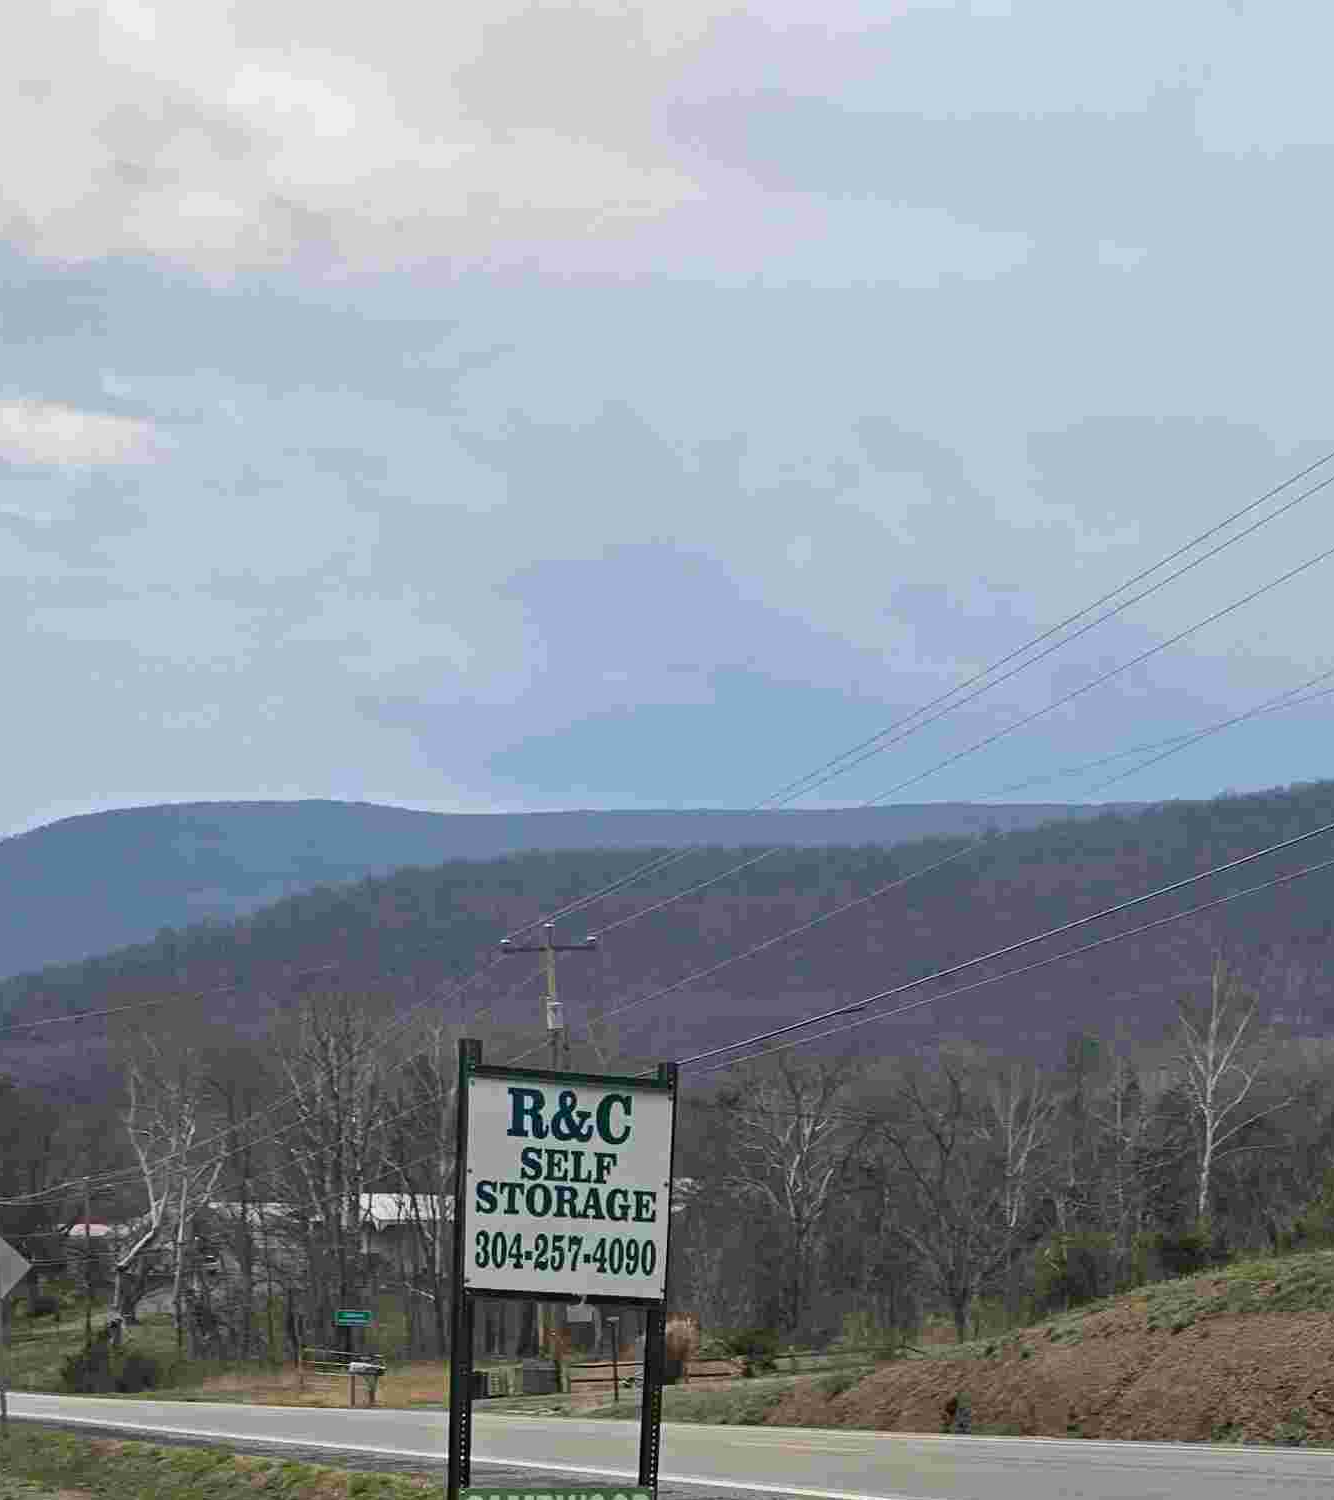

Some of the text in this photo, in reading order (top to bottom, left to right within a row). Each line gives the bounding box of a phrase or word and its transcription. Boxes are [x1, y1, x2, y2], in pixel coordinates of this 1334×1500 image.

[507, 1087, 633, 1144] R&C
[520, 1147, 617, 1184] SELF
[475, 1180, 657, 1223] STORAGE
[475, 1230, 657, 1276] 304-257-4090
